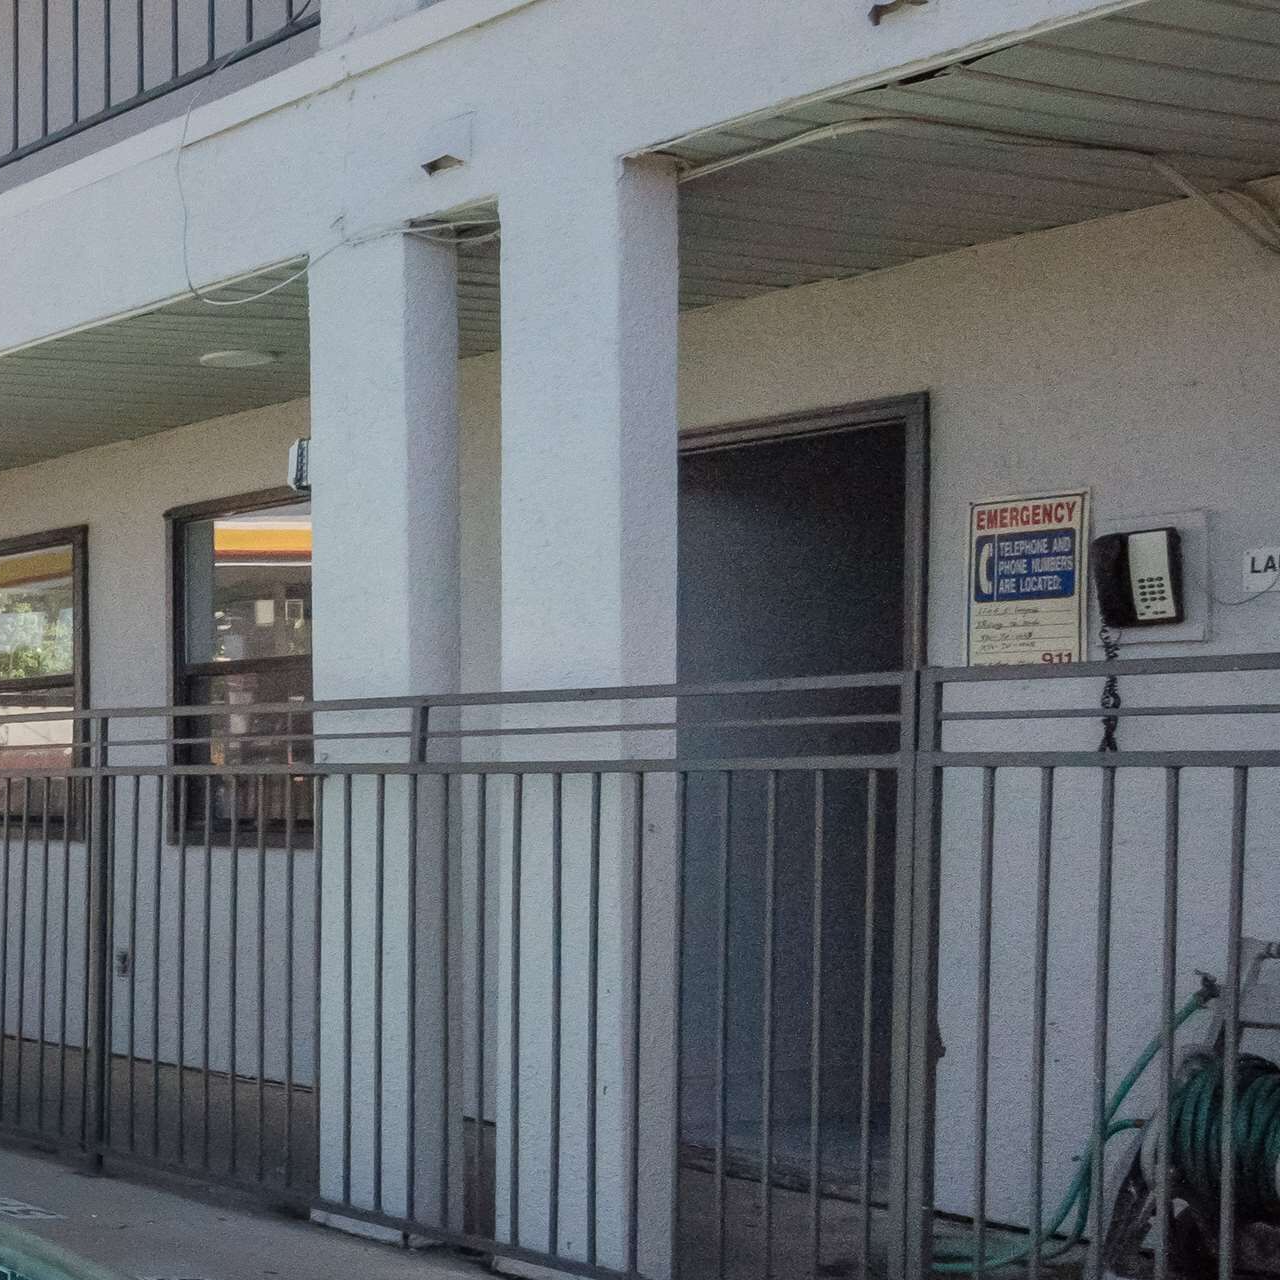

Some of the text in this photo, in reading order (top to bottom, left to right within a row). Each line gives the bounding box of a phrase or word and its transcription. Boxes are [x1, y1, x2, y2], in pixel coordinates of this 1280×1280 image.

[975, 502, 1077, 531] EMERGENCY
[999, 536, 1072, 557] TELEPHONE AND
[998, 555, 1073, 576] PHONE NUMBERS
[1250, 554, 1280, 574] LA
[999, 578, 1017, 595] ARE
[1042, 652, 1072, 664] 911
